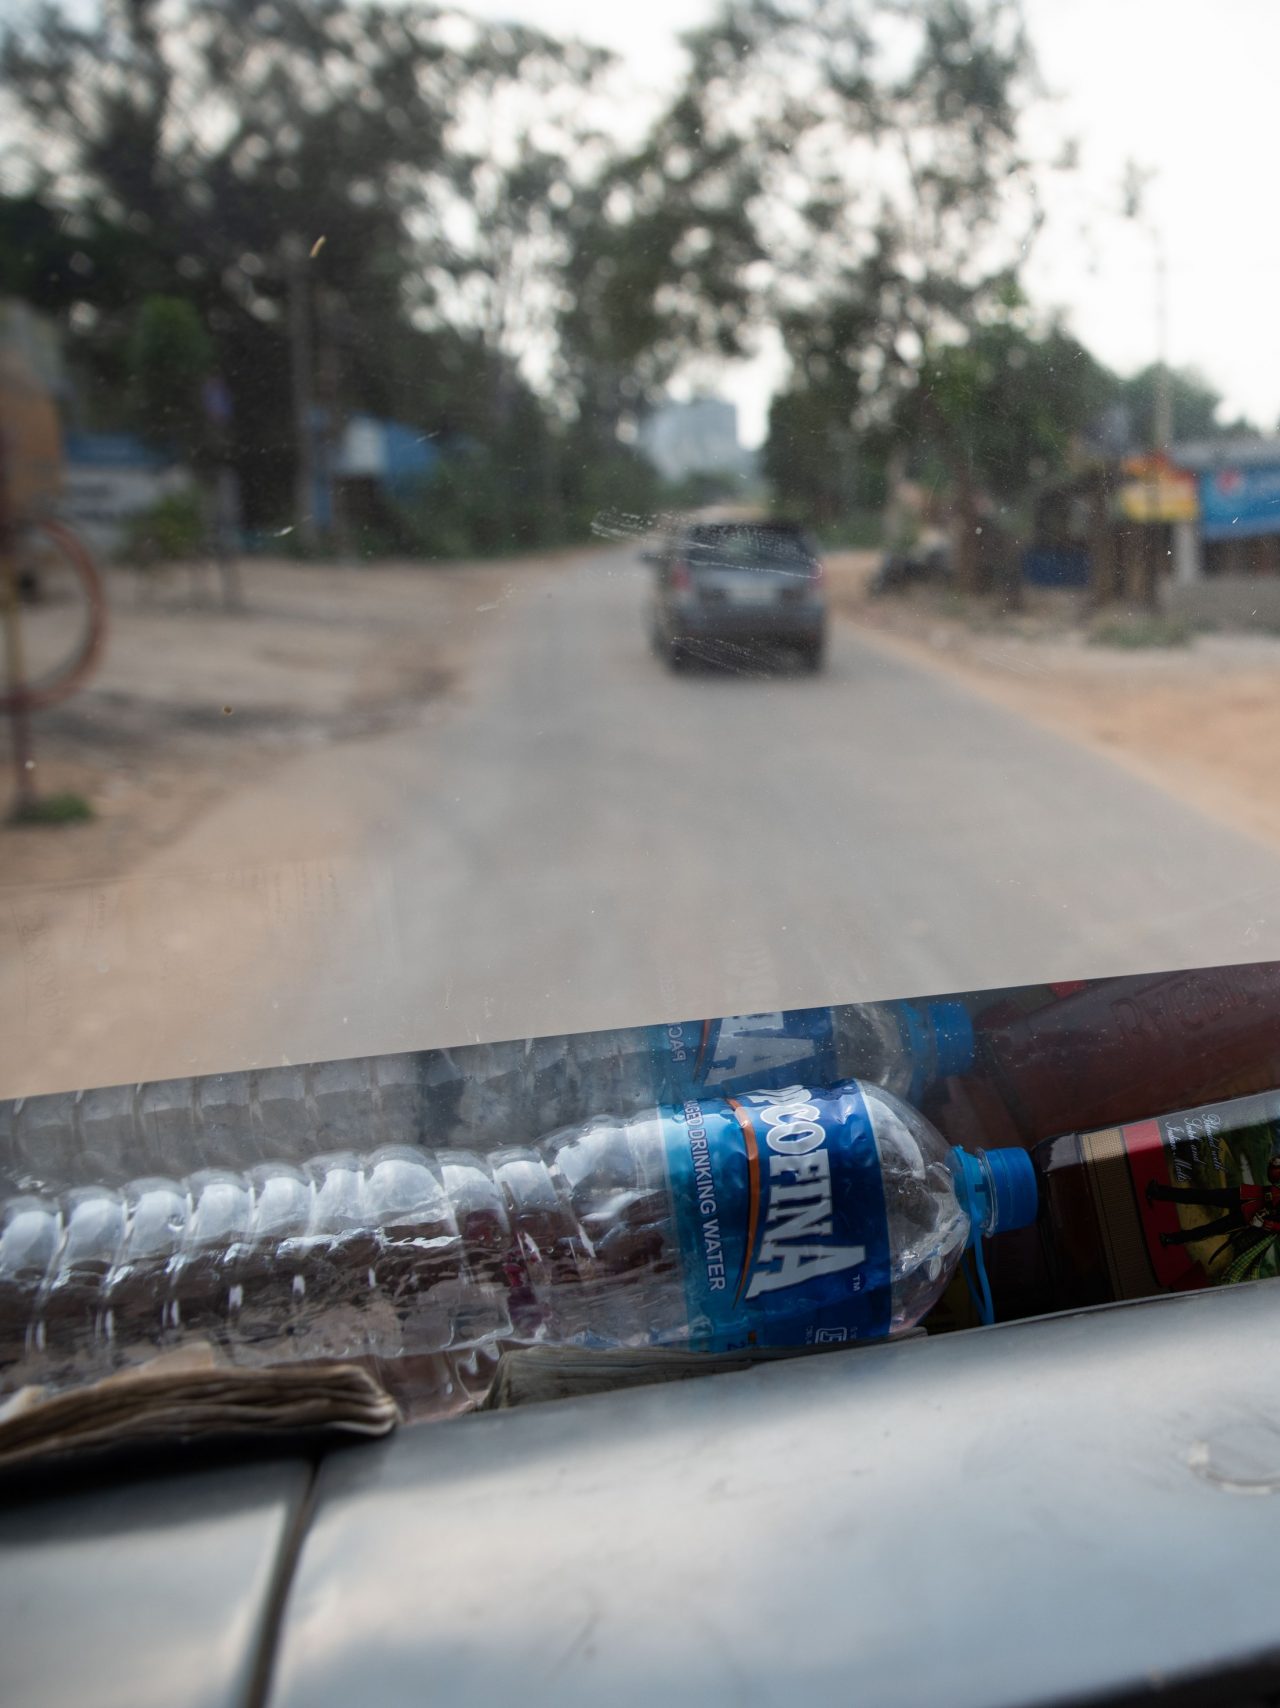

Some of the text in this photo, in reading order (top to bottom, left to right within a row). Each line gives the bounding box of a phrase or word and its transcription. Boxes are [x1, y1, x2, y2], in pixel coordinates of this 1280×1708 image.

[1191, 1144, 1207, 1165] and
[1201, 1113, 1228, 1172] Blended with
[687, 1129, 717, 1216] DRINKING
[702, 1217, 725, 1291] WATER
